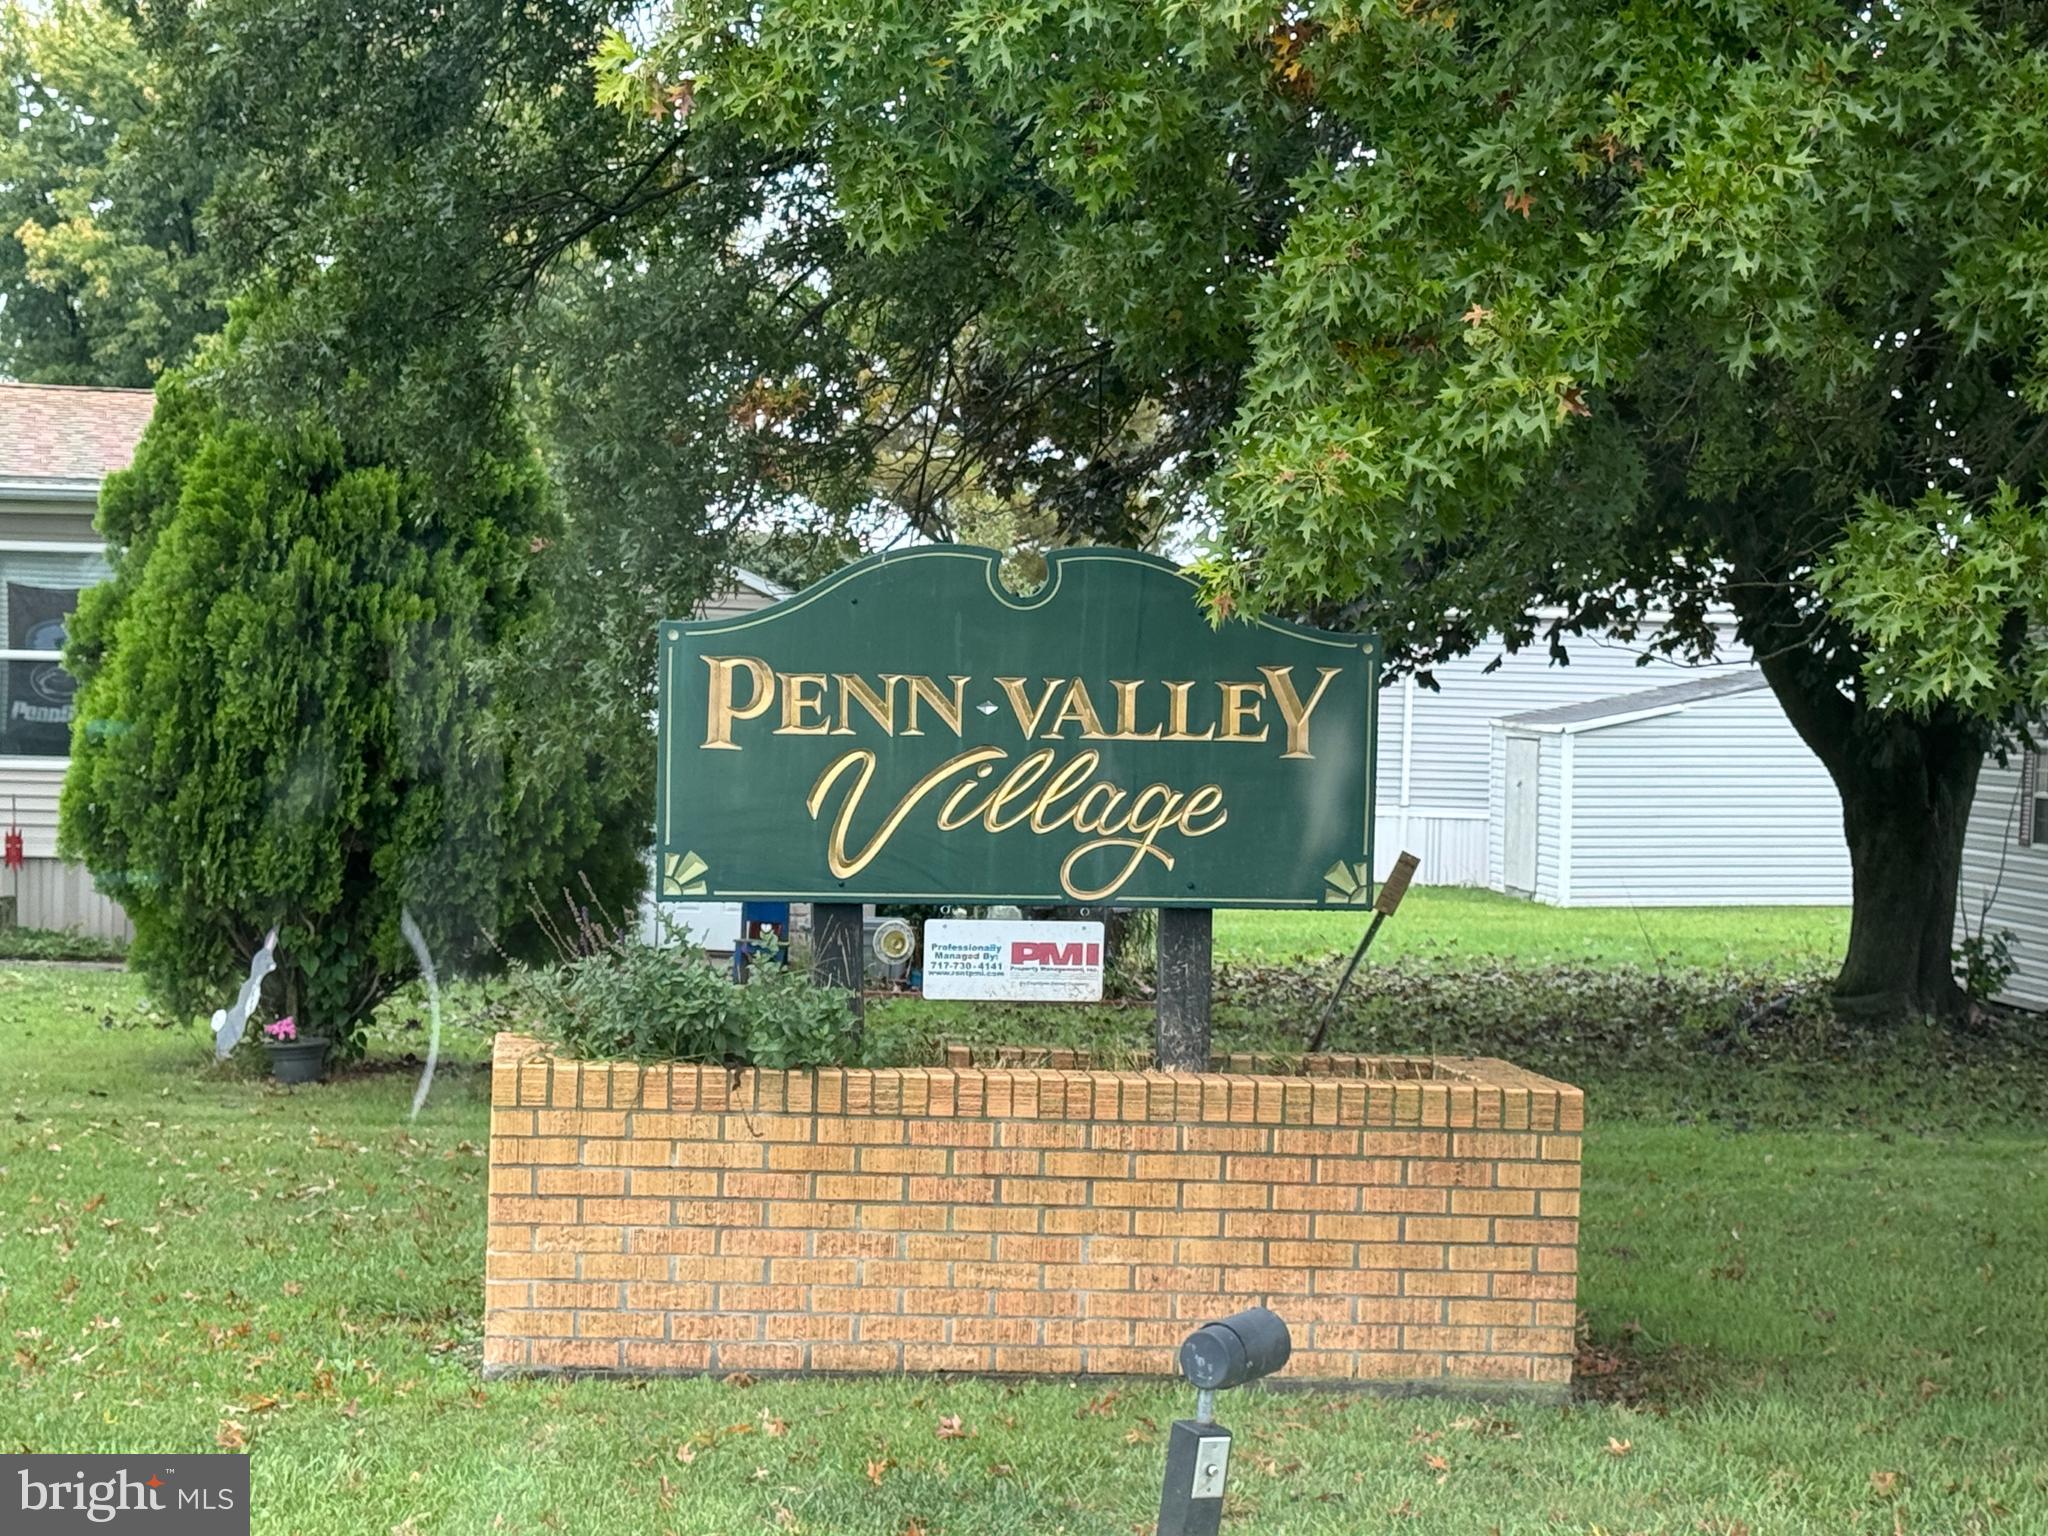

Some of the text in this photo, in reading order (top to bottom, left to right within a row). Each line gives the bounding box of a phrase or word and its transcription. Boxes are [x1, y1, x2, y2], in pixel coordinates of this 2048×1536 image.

[699, 653, 1343, 760] PENN VALLEY
[806, 744, 1229, 902] Village
[931, 943, 1002, 954] Professionally
[934, 952, 999, 961] Managed By:
[1011, 942, 1100, 965] PMI
[930, 961, 1003, 970] 717-730-4141
